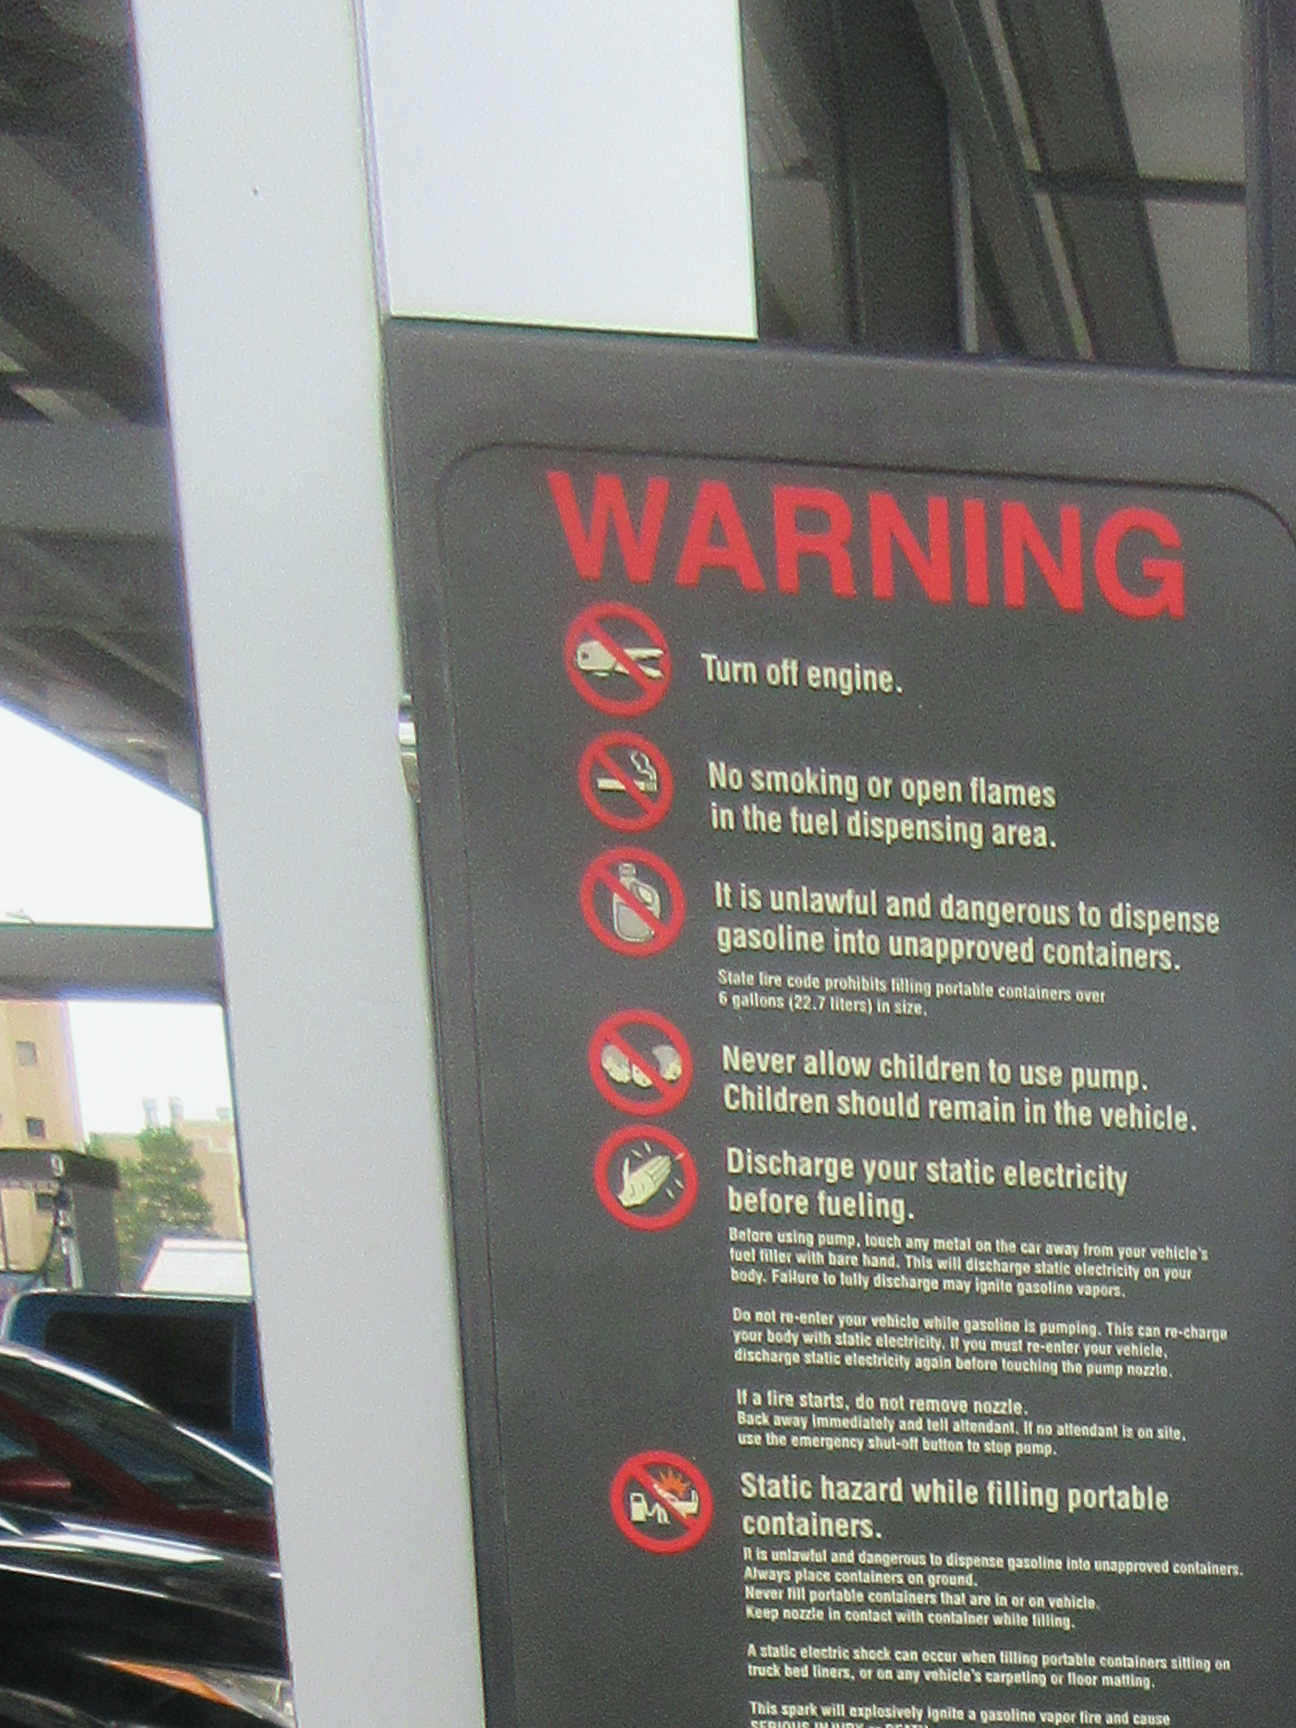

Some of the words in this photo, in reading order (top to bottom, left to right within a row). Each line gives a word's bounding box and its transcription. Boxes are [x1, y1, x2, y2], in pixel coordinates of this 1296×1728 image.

[548, 471, 1185, 619] WARNING
[699, 651, 757, 684] Turn
[765, 657, 798, 686] off
[806, 661, 903, 696] engine.
[707, 759, 743, 790] No
[750, 765, 859, 802] smoking
[867, 775, 893, 798] or
[900, 777, 962, 806] open
[969, 775, 1056, 807] flames
[710, 800, 735, 830] in
[741, 802, 782, 833] the
[789, 805, 838, 835] fuel
[846, 808, 983, 850] dispensing
[991, 822, 1057, 848] area.
[714, 880, 732, 908] It
[739, 881, 762, 910] is
[769, 885, 877, 915] unlawful
[885, 891, 931, 918] and
[939, 892, 1070, 928] dangerous
[1077, 900, 1101, 927] to
[1109, 901, 1220, 936] dispense
[716, 923, 825, 953] gasoline
[833, 926, 880, 955] into
[888, 934, 1034, 965] unapproved
[1042, 939, 1181, 970] containers.
[721, 1044, 797, 1073] Never
[803, 1048, 872, 1077] allow
[879, 1052, 980, 1082] children
[987, 1057, 1011, 1084] to
[1019, 1064, 1063, 1086] use
[1070, 1066, 1148, 1096] pump.
[723, 1082, 829, 1114] Children
[836, 1088, 919, 1118] should
[927, 1095, 1015, 1122] remain
[1023, 1096, 1046, 1124] in
[1053, 1098, 1092, 1127] the
[1099, 1102, 1197, 1132] vehicle.
[726, 1146, 854, 1183] Discharge
[861, 1158, 918, 1184] your
[925, 1156, 995, 1185] static
[1003, 1159, 1128, 1196] electricity
[727, 1184, 809, 1215] before
[816, 1189, 915, 1225] fueling.
[740, 1471, 812, 1499] Static
[820, 1474, 903, 1502] hazard
[910, 1477, 979, 1505] while
[986, 1479, 1059, 1513] filling
[1067, 1484, 1169, 1513] portable
[741, 1510, 882, 1539] containers.
